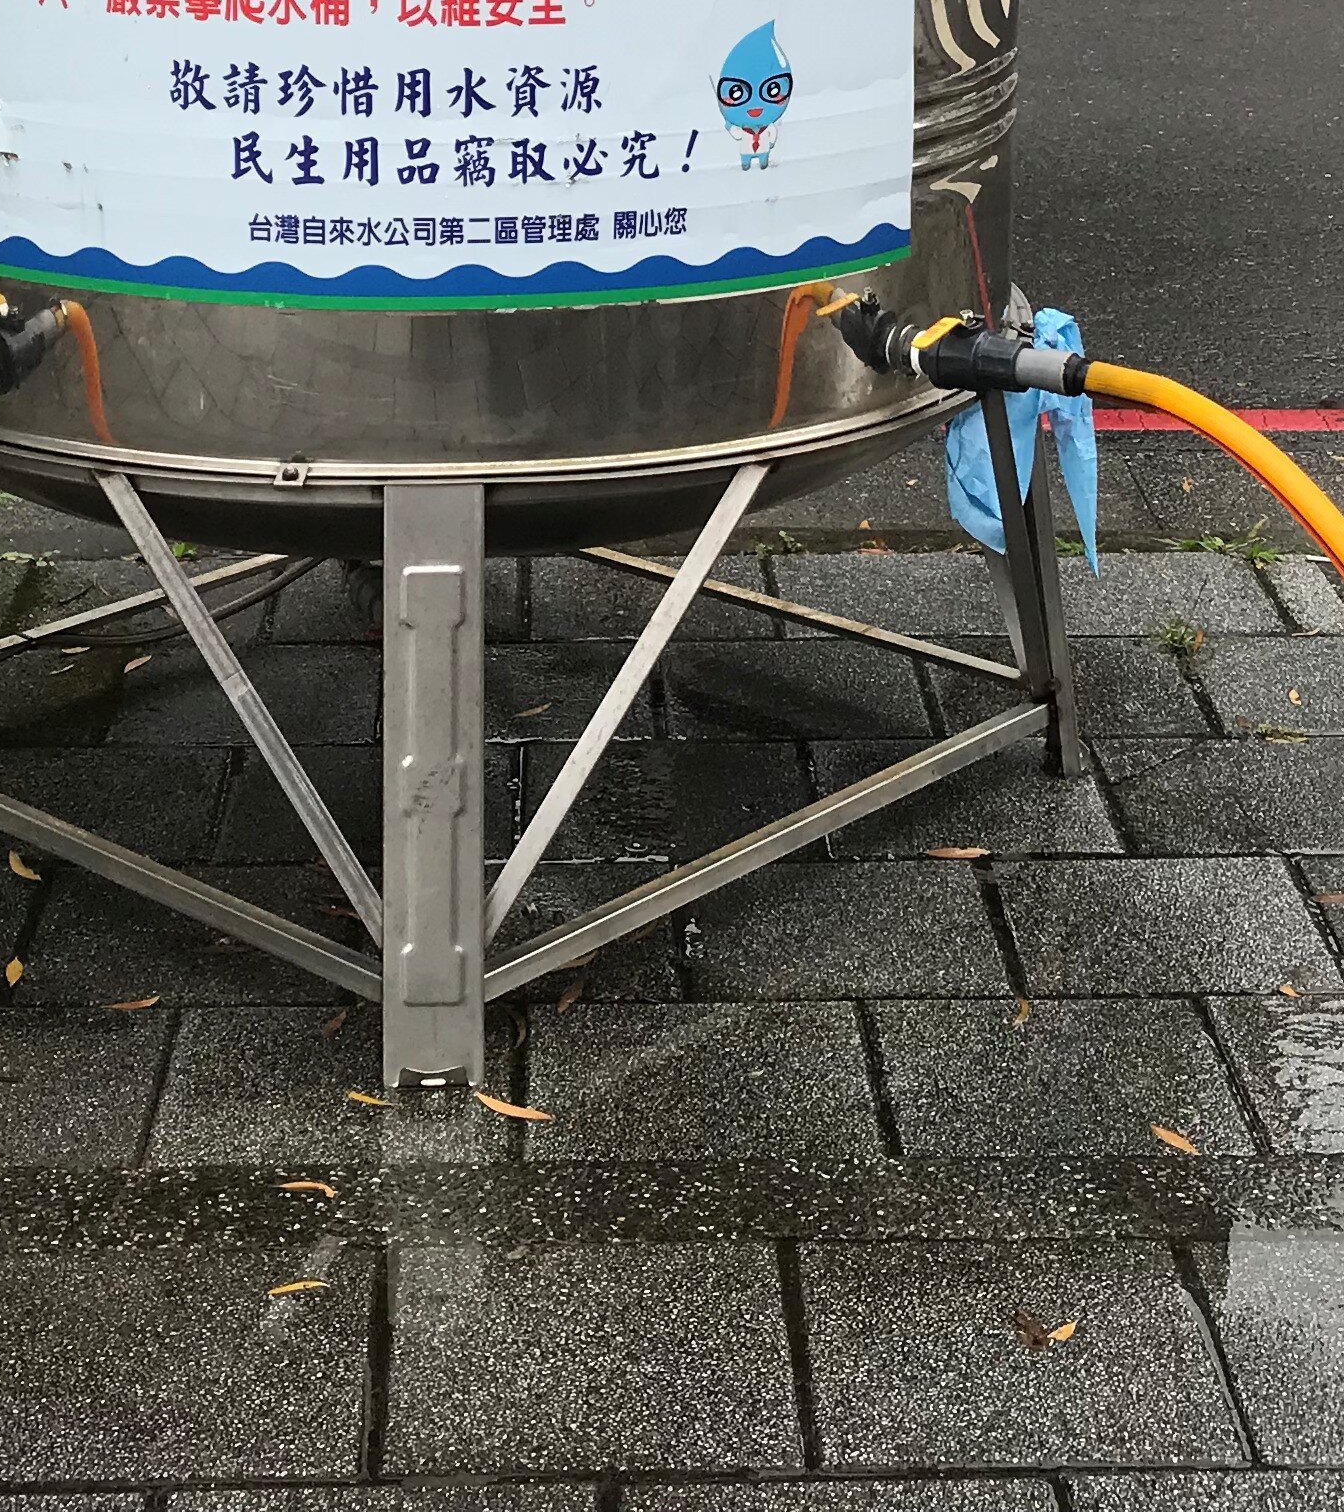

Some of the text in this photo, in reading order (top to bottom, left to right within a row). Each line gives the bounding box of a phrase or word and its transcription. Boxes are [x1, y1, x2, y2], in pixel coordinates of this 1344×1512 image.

[169, 59, 605, 118] 敬請珍惜用水資源
[248, 206, 689, 247] 台灣自來水公司第二區管理處 關心您
